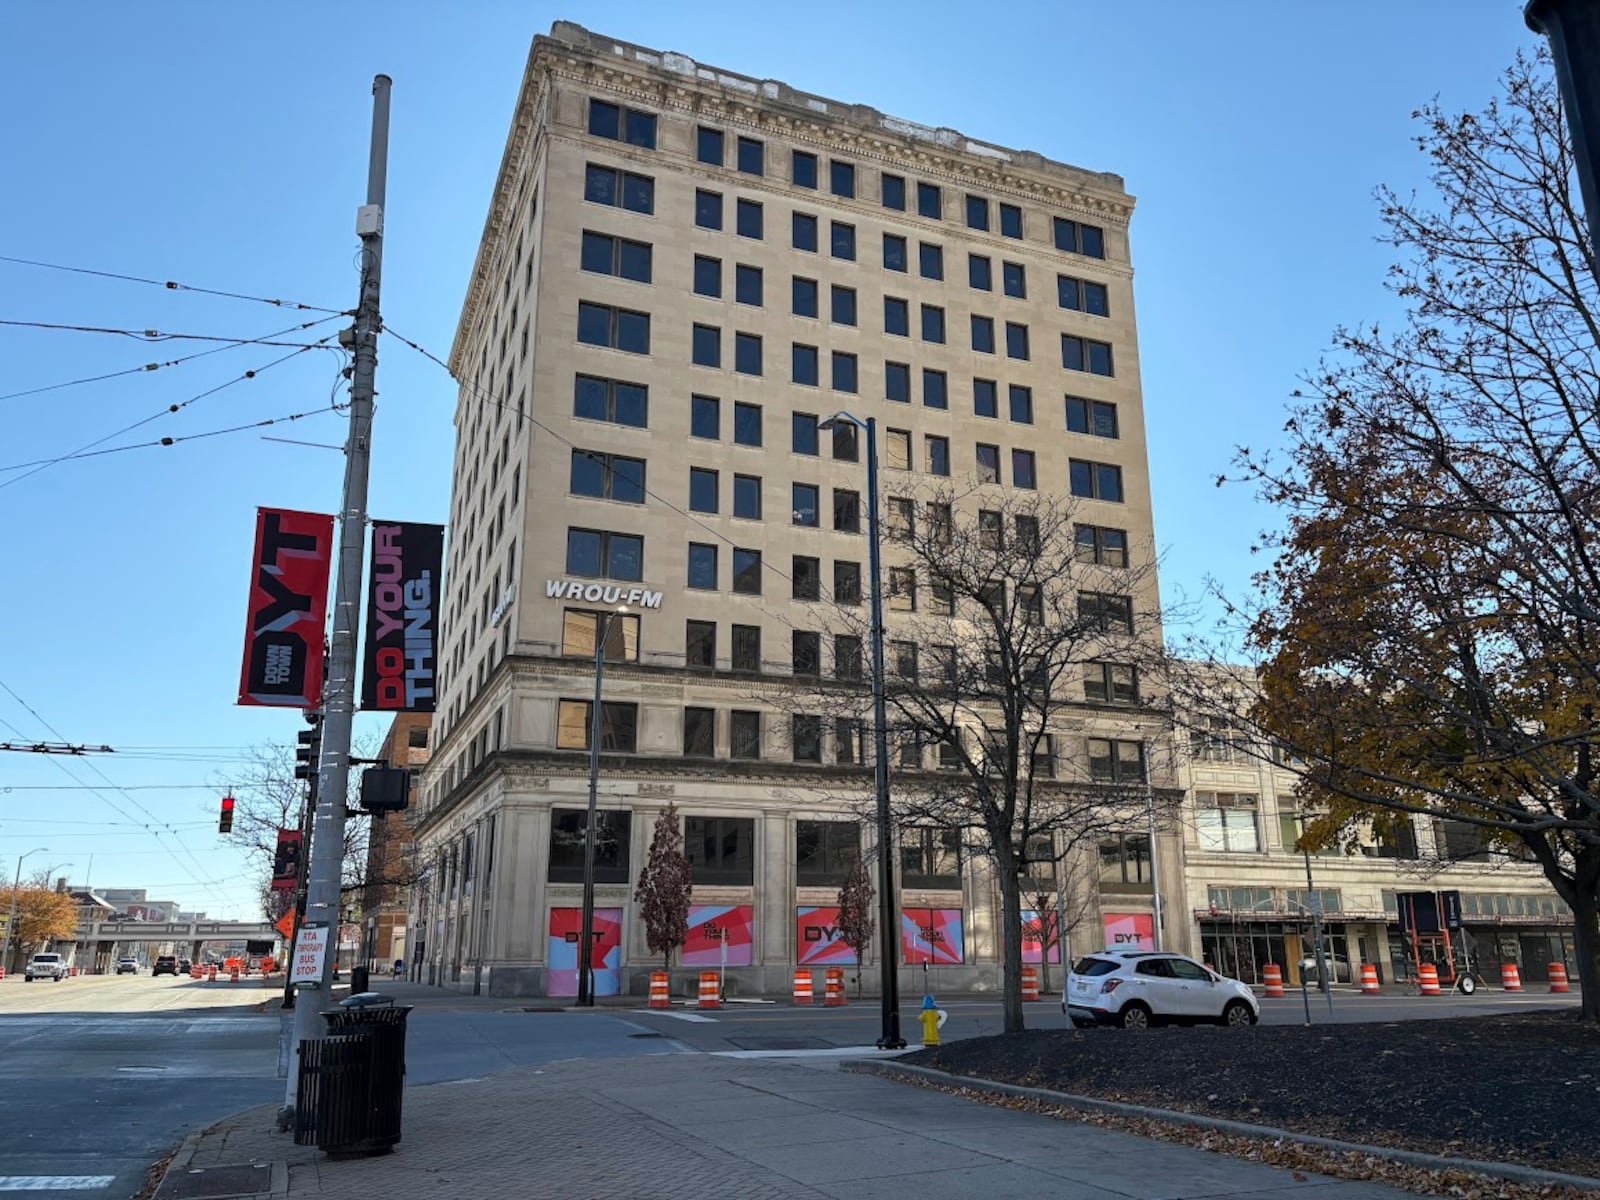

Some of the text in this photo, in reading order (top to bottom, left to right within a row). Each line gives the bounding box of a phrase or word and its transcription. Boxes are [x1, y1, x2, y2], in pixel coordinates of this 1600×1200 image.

[247, 513, 318, 697] DYT
[545, 580, 663, 609] WROU-FM
[375, 525, 404, 708] DO YOUR
[404, 569, 433, 707] THING.
[264, 643, 281, 684] DOWN
[277, 645, 292, 684] TOWN
[303, 931, 317, 940] RTA
[565, 931, 605, 943] DT
[805, 926, 852, 942] DY
[1115, 933, 1142, 943] DYT
[299, 955, 315, 964] BUS
[296, 966, 317, 976] STOP
